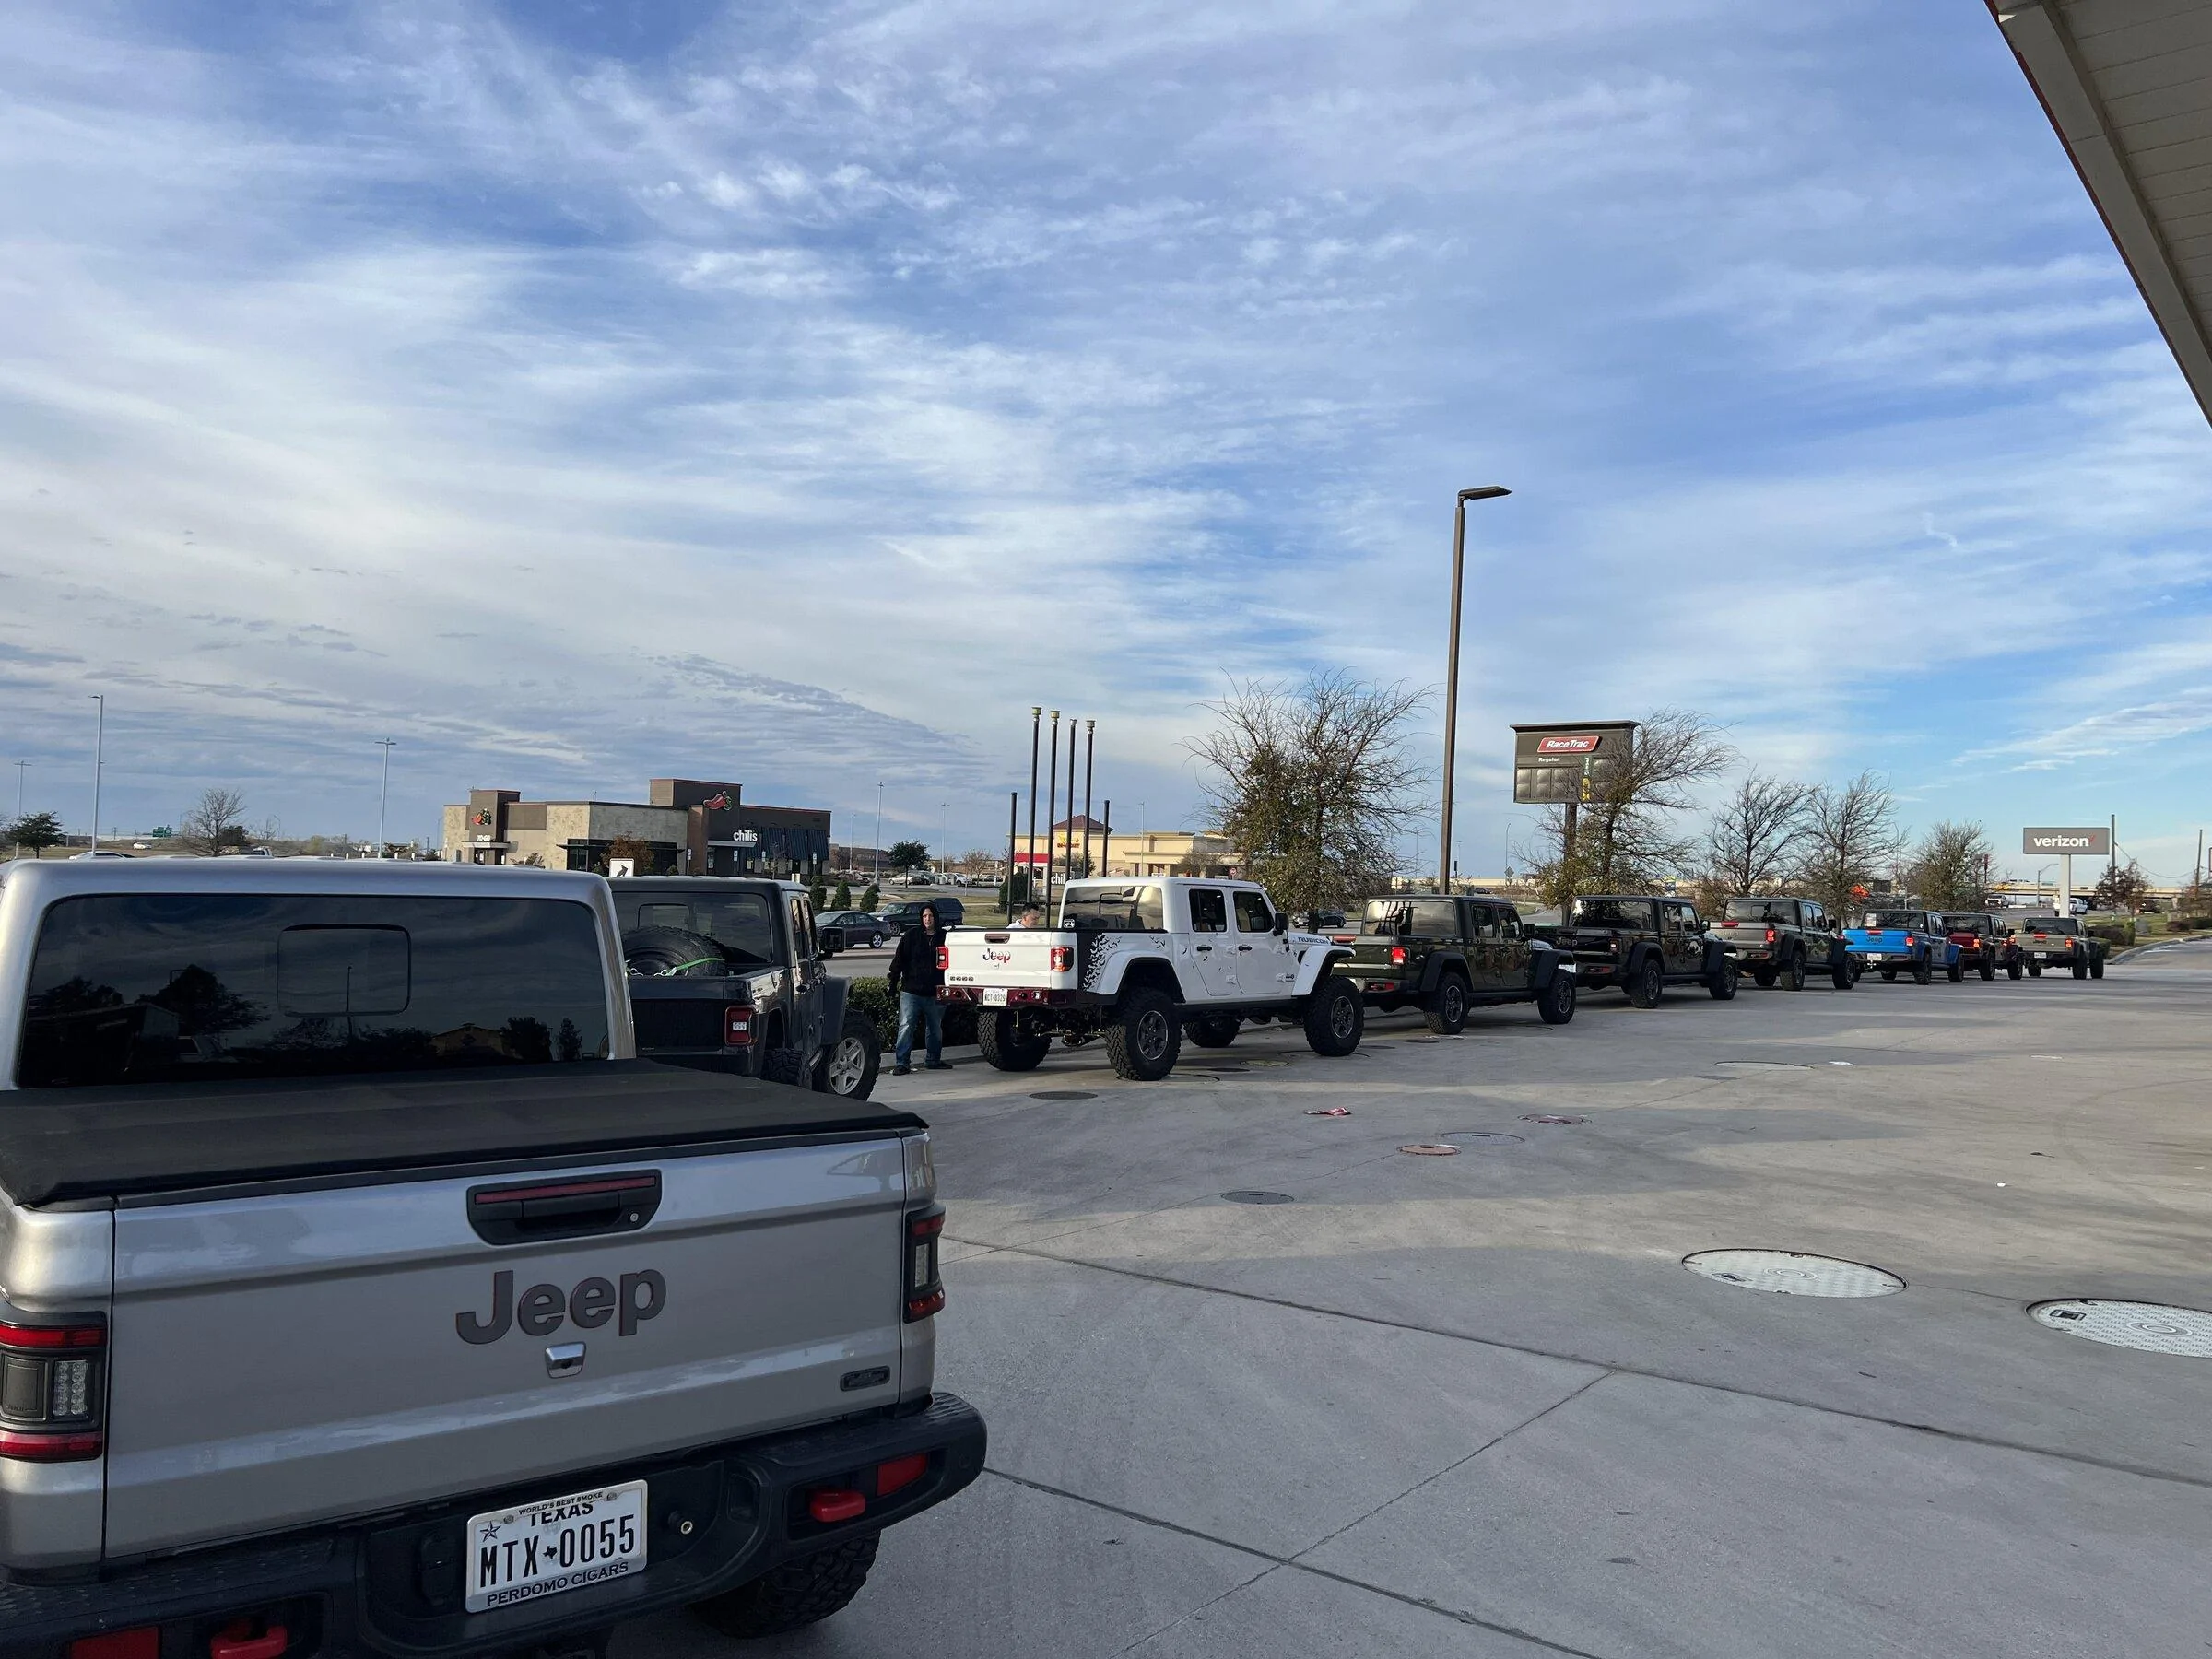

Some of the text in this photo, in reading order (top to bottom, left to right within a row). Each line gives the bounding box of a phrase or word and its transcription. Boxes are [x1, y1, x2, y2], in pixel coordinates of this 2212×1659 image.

[1546, 739, 1589, 748] RaceTrac
[2033, 835, 2089, 847] verizon
[982, 947, 1011, 963] Jeep
[455, 1268, 666, 1345] Jeep
[518, 1492, 603, 1515] WORLD'S BEST SMOKE
[530, 1502, 593, 1526] TEXAS
[487, 1562, 629, 1606] PERDOMO CIGARS
